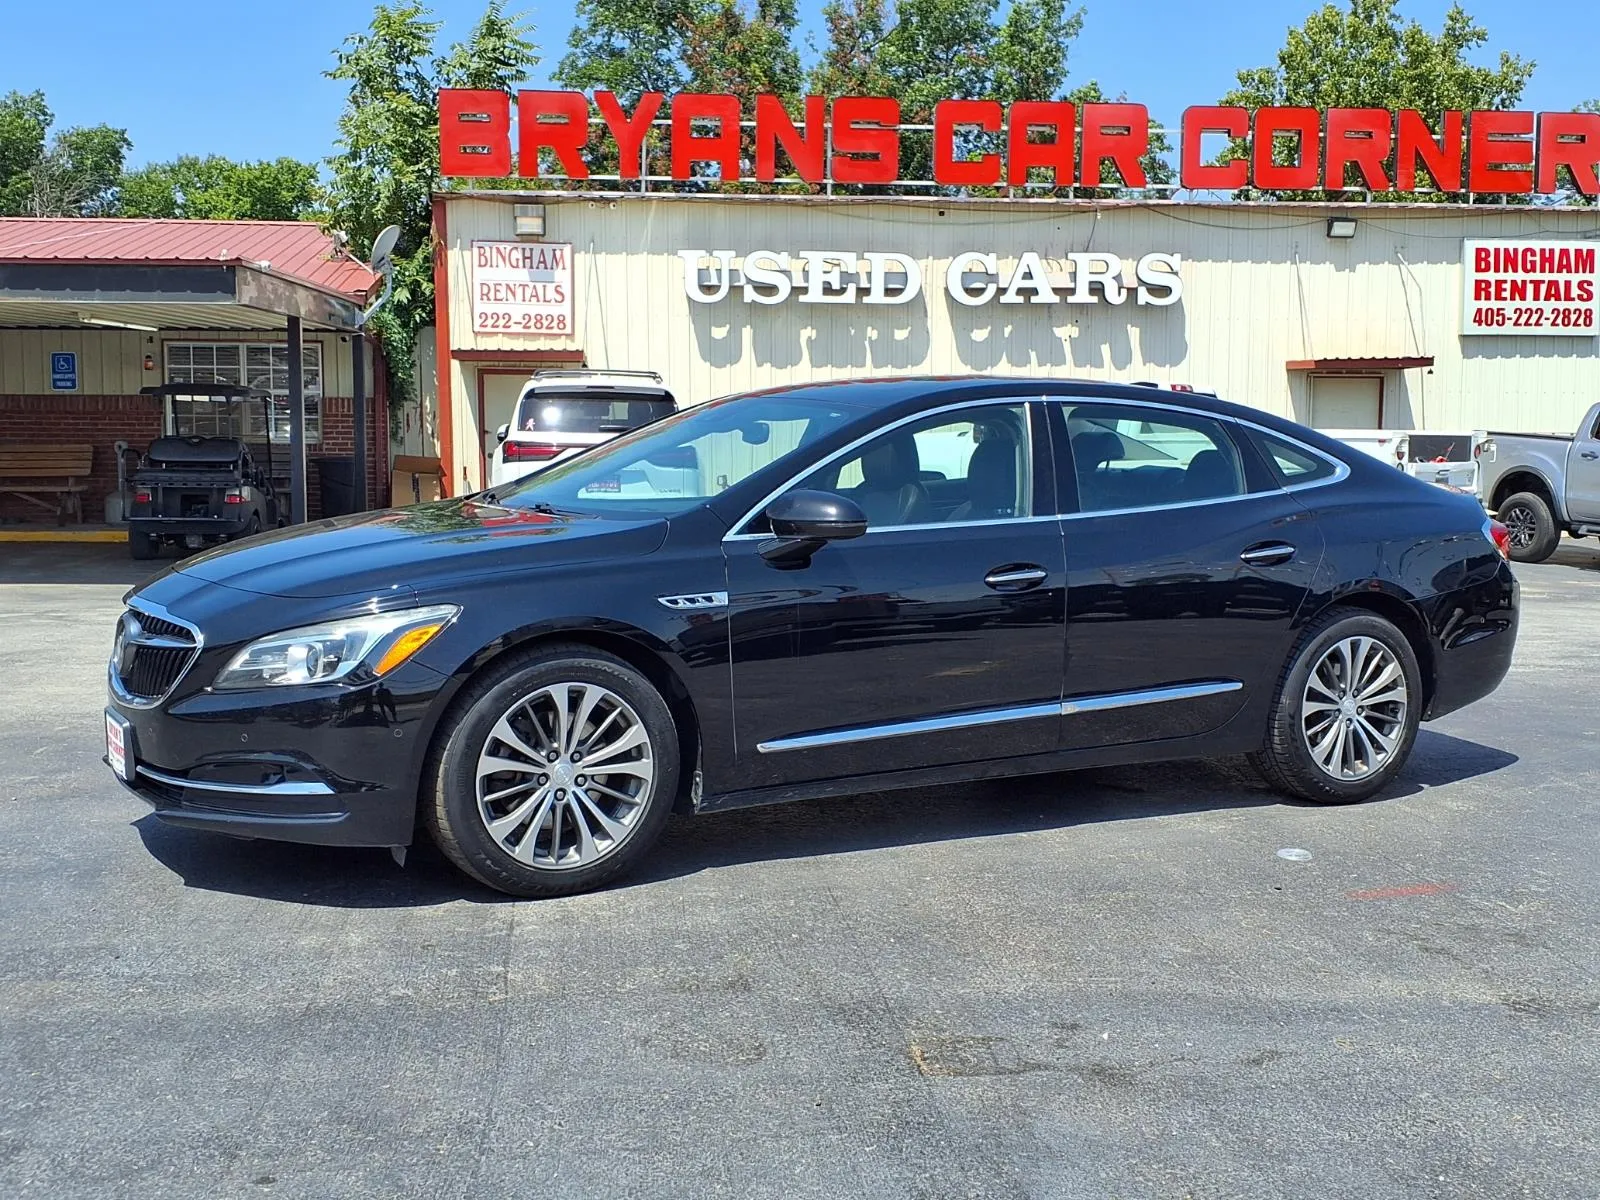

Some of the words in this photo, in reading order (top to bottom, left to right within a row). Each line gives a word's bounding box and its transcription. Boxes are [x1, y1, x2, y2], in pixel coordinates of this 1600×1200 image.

[438, 88, 900, 184] BRYANS
[934, 99, 1149, 188] CAR
[1181, 105, 1600, 196] CORNER
[477, 246, 567, 271] BINGHAM
[1474, 247, 1596, 274] BINGHAM
[677, 249, 923, 305] USED
[945, 251, 1185, 306] CARS
[479, 282, 566, 304] RENTALS
[1473, 279, 1594, 302] RENTALS
[478, 312, 567, 331] 222-2828
[1472, 307, 1594, 328] 405-222-2828
